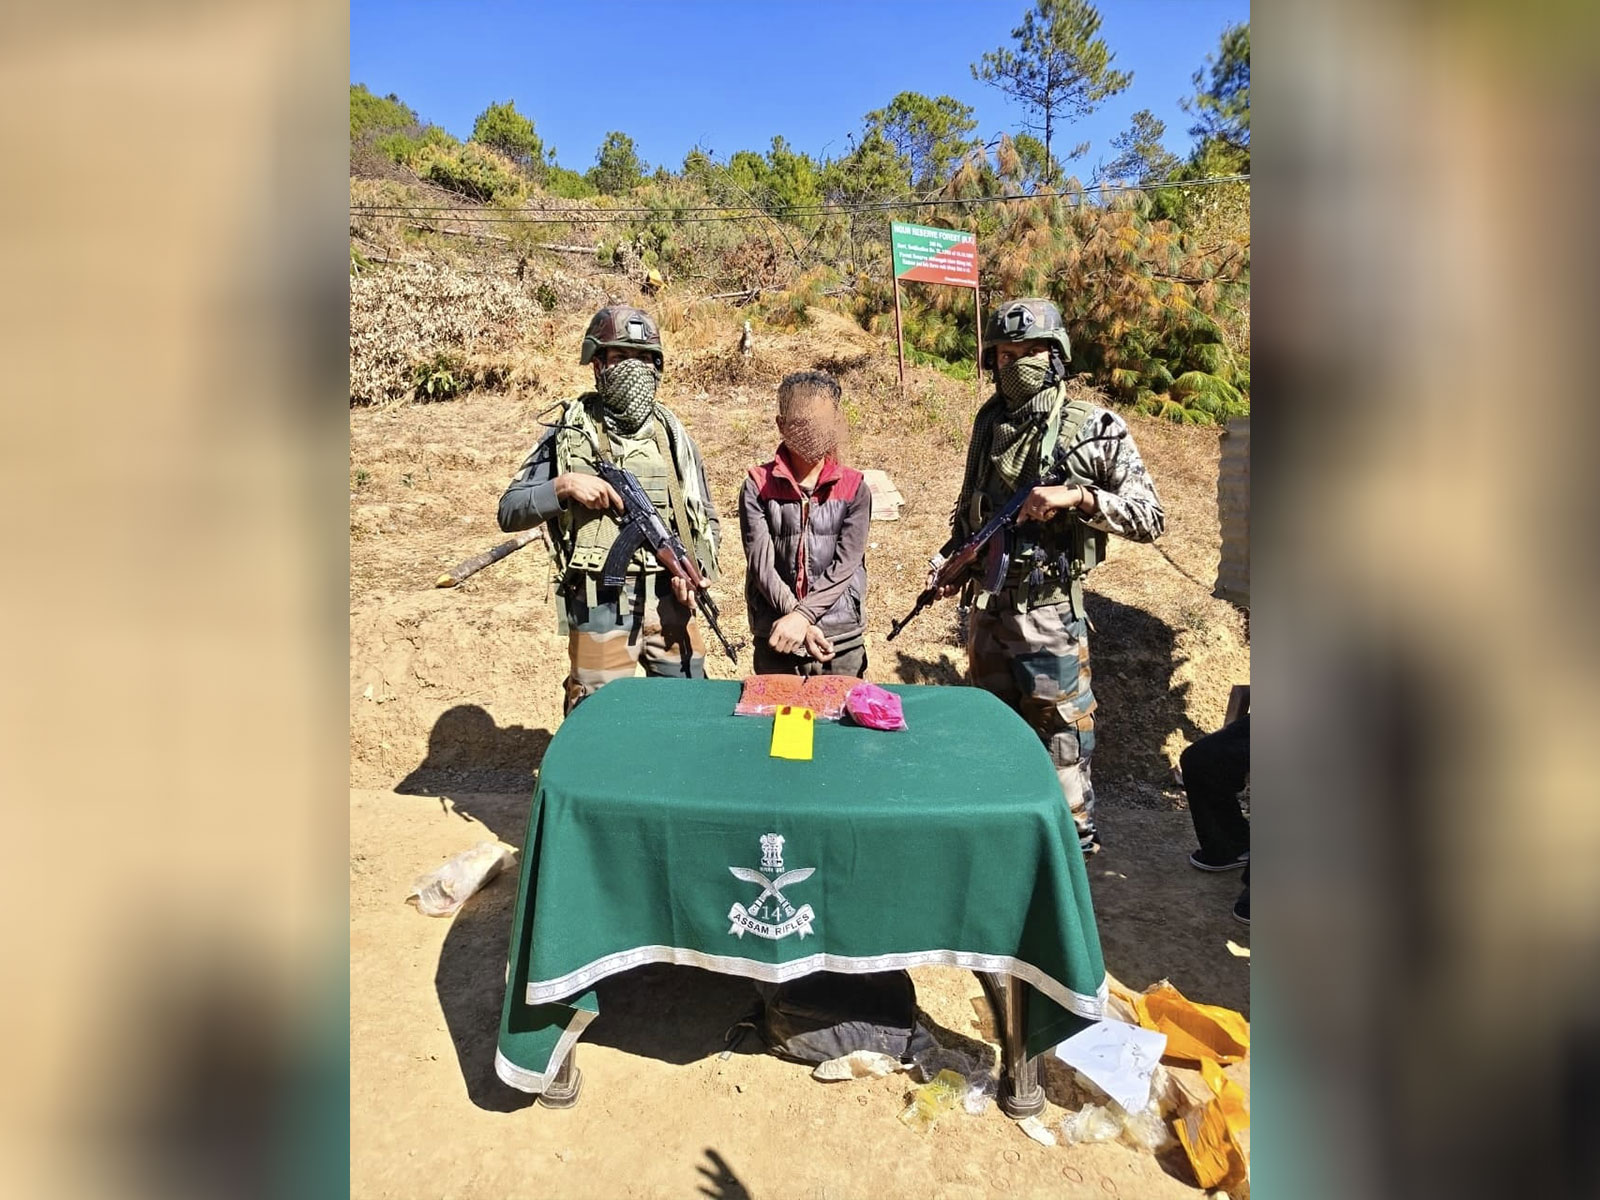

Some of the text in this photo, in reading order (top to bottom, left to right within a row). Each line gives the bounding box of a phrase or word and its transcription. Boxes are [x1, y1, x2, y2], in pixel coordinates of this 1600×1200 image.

[912, 227, 938, 239] RESERVE
[939, 232, 960, 242] FOREST
[761, 905, 782, 923] 14
[733, 913, 810, 936] ASSAM RIFLES
